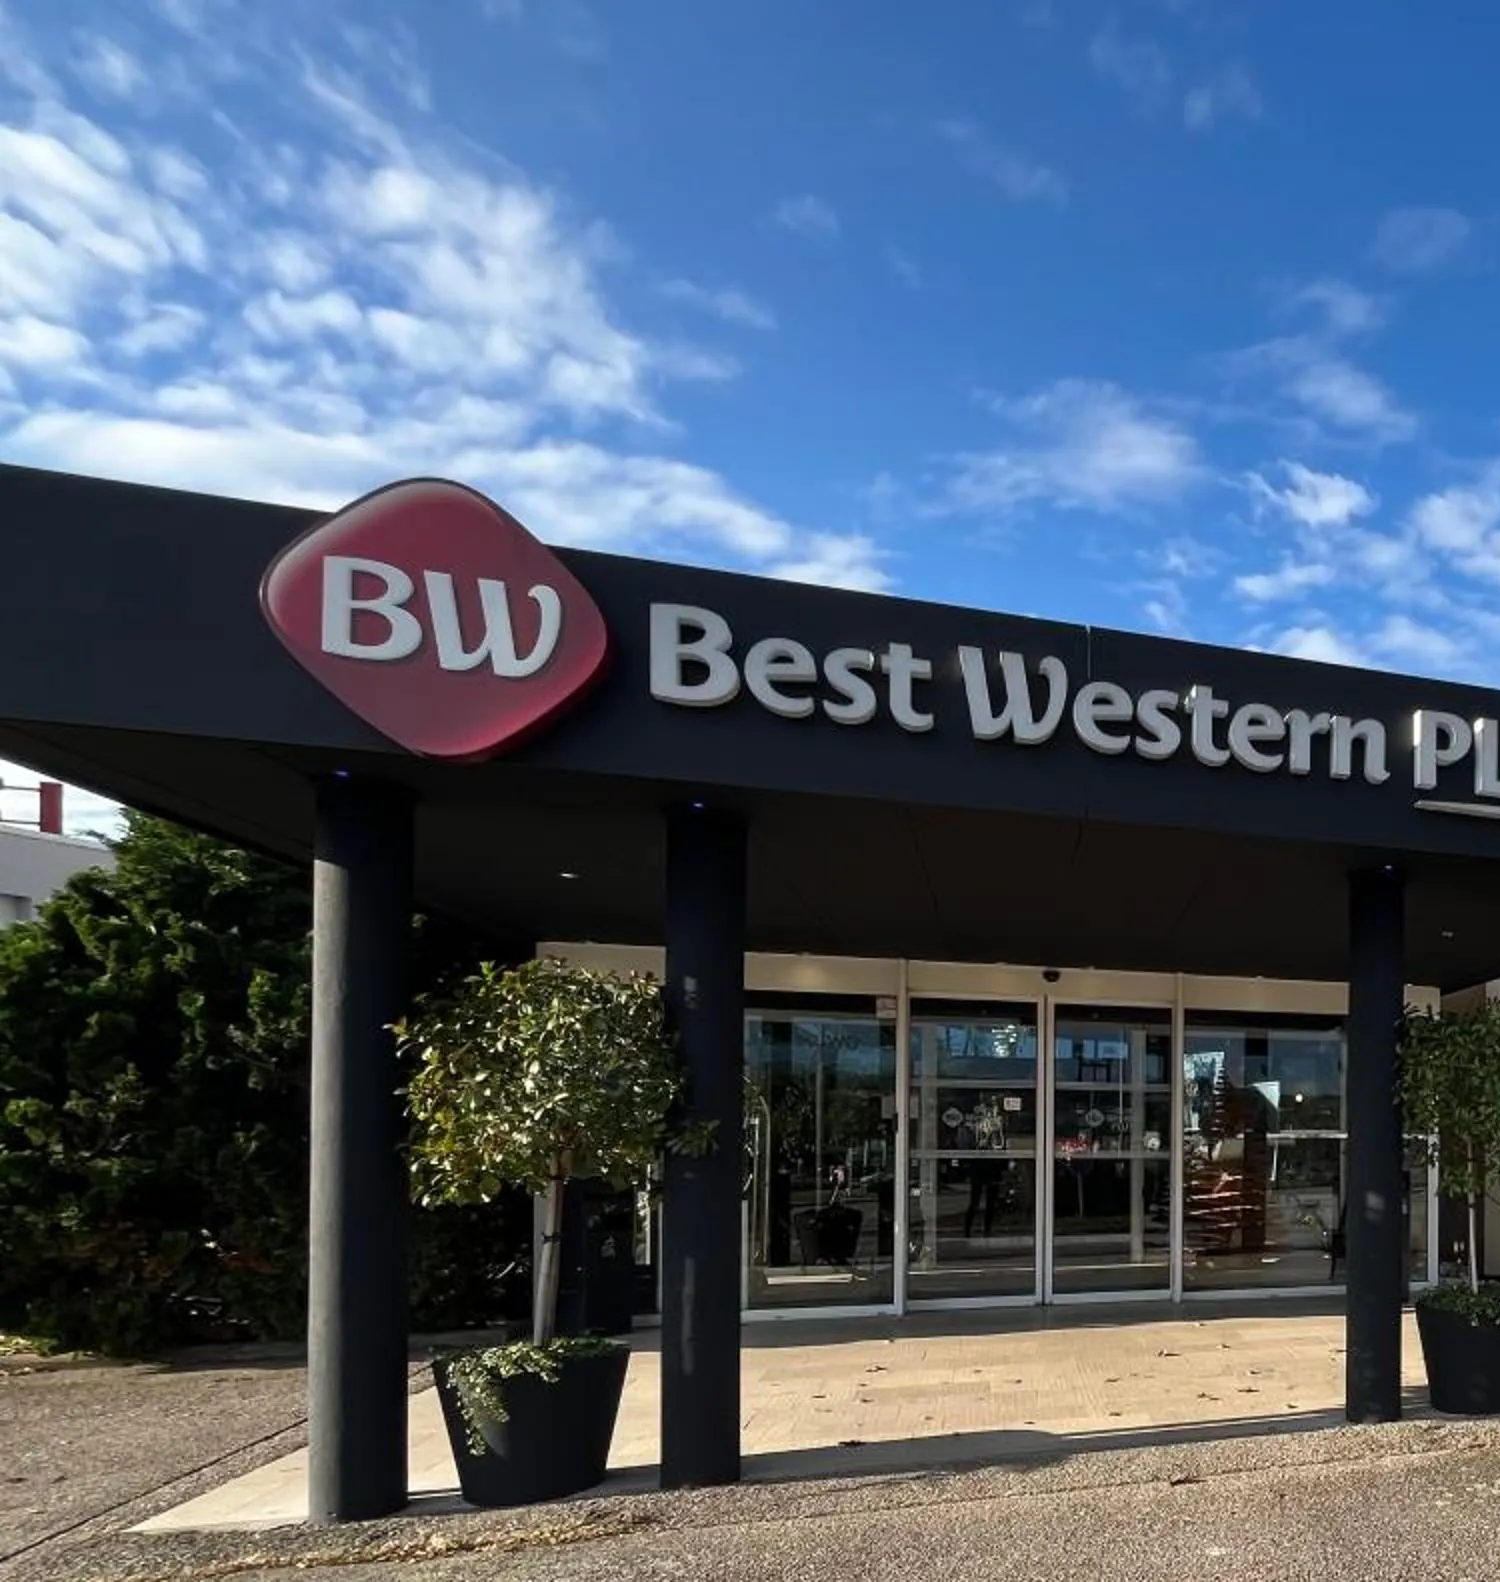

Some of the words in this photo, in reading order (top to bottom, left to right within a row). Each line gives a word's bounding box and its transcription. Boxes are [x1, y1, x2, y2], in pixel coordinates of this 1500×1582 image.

[321, 555, 562, 678] BW
[649, 602, 935, 733] Best
[957, 645, 1391, 785] Western
